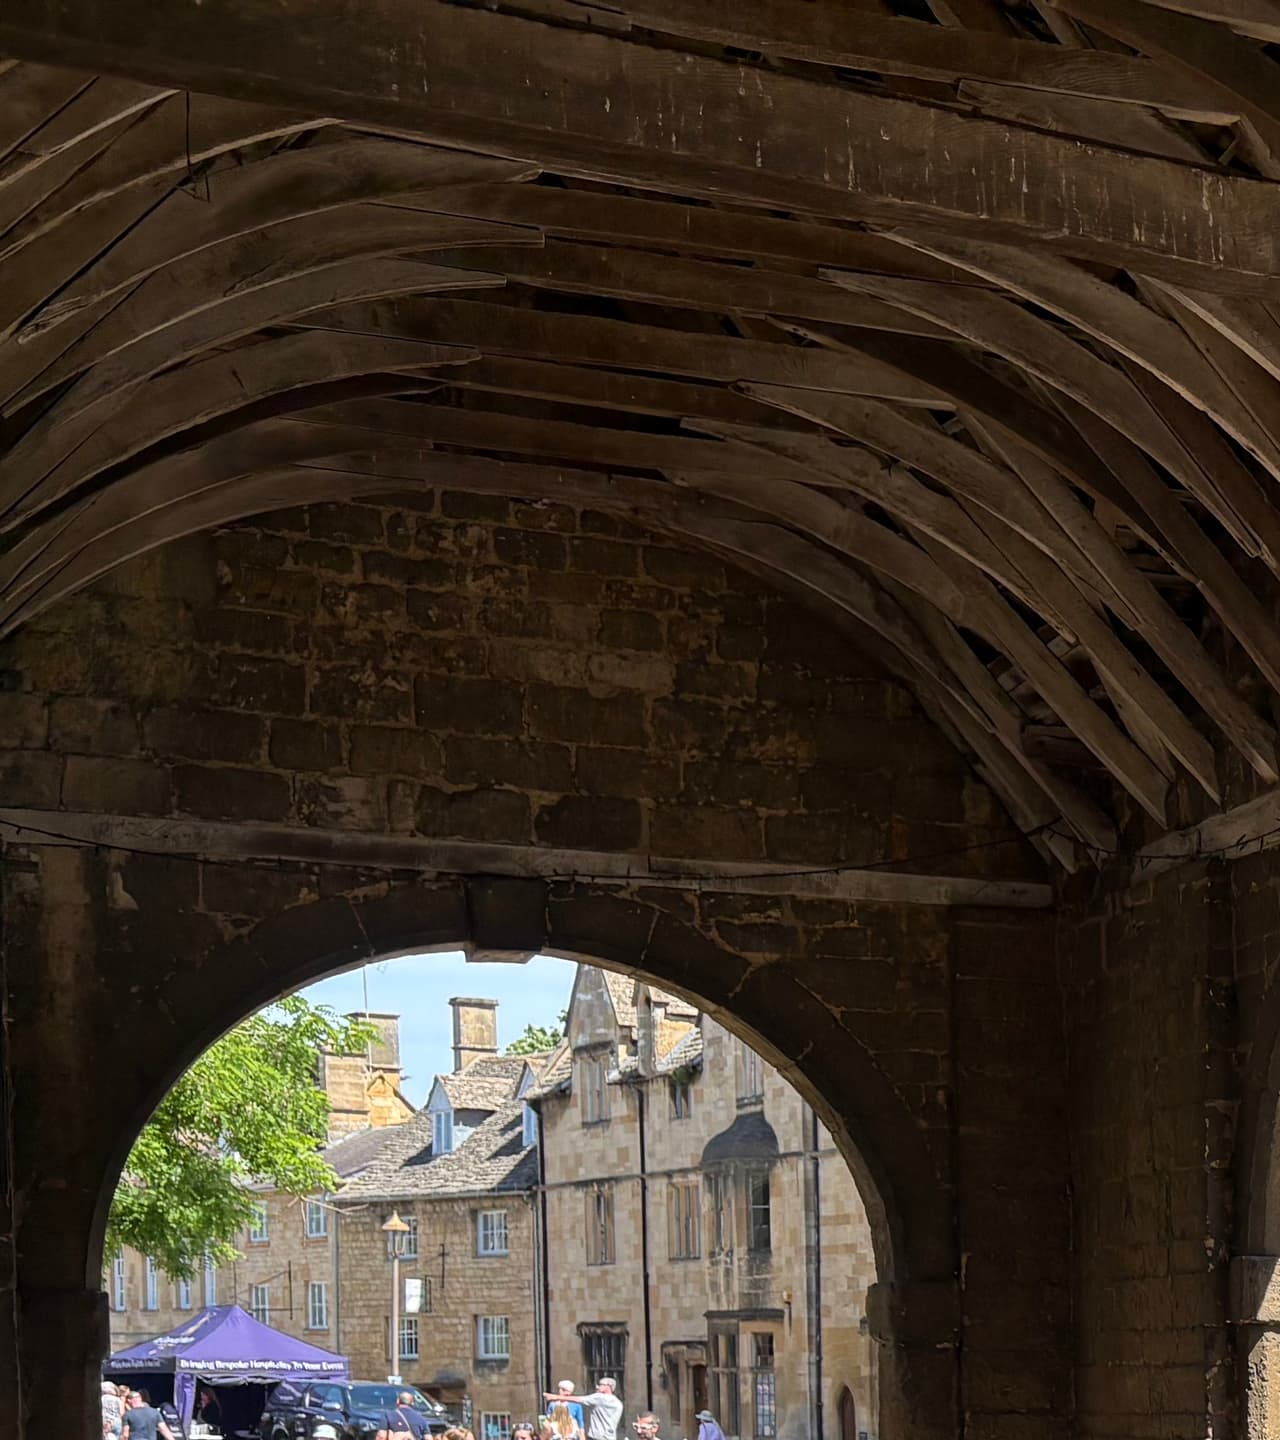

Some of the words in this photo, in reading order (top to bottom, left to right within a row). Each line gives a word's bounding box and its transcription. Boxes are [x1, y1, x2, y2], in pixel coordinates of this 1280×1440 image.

[180, 1359, 215, 1370] Bringing
[215, 1360, 250, 1370] Bespoke
[292, 1360, 303, 1370] To
[303, 1361, 321, 1370] Your
[322, 1361, 344, 1370] Event
